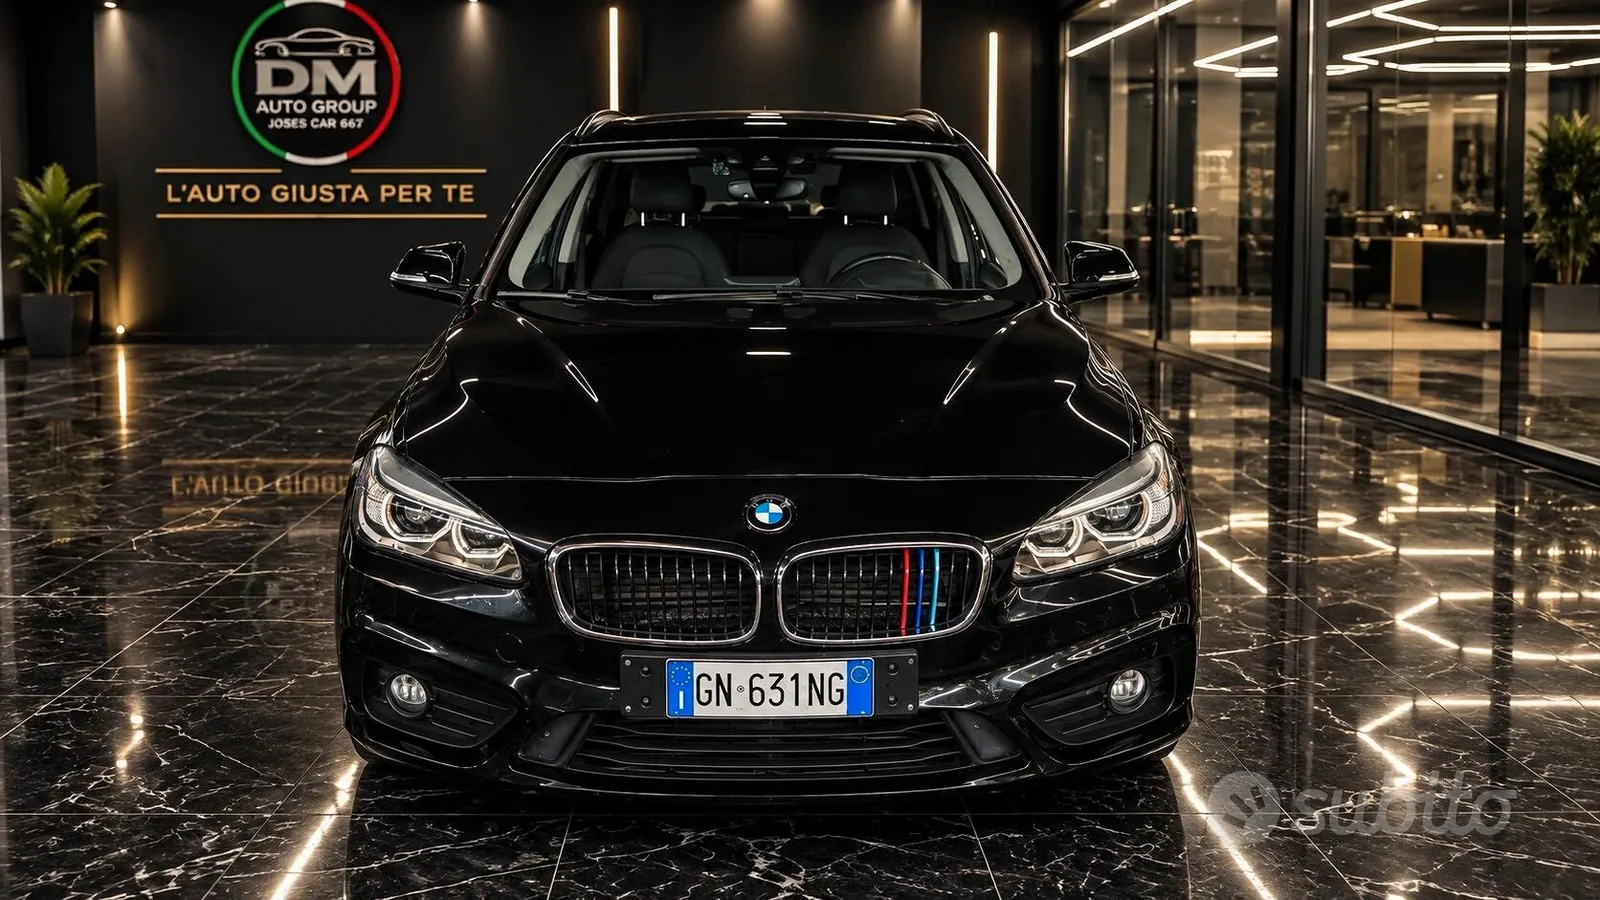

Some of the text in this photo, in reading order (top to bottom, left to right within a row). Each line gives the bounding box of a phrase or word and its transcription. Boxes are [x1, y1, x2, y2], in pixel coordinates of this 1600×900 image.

[256, 60, 376, 95] DM
[256, 100, 377, 113] AUTO GROUP
[310, 118, 336, 128] CAR
[340, 118, 363, 128] 667
[167, 184, 474, 202] L'AUTO GIUSTA PER TE
[697, 673, 731, 706] GN
[749, 673, 843, 706] 631NG
